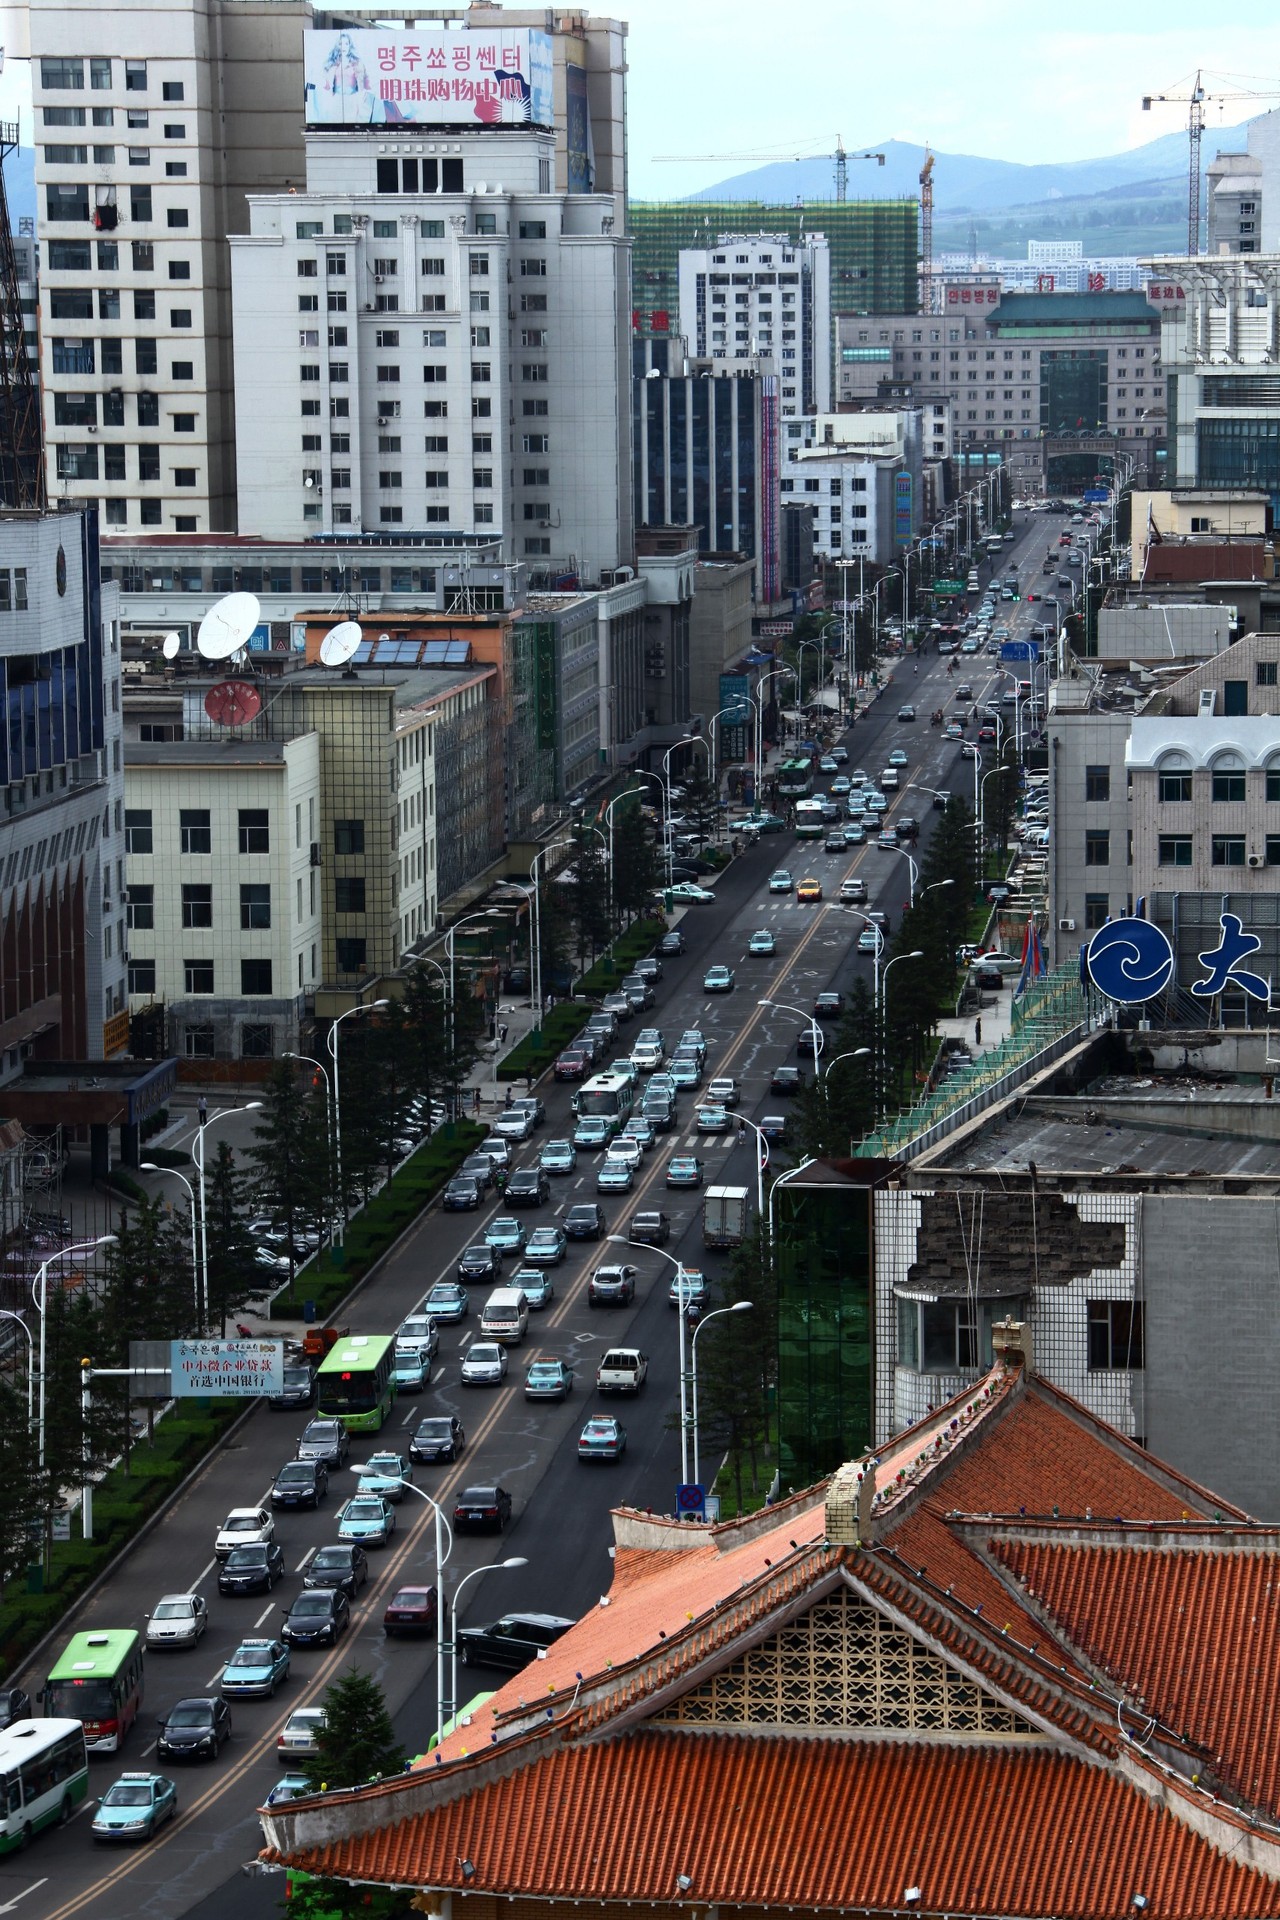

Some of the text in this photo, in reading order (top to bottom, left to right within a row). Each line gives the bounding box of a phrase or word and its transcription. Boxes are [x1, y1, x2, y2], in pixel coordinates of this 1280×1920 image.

[379, 78, 523, 102] 明珠购物中心
[1190, 912, 1271, 1001] 大
[182, 1360, 272, 1372] 中小微企业贷款
[189, 1375, 265, 1388] 首选中国银行
